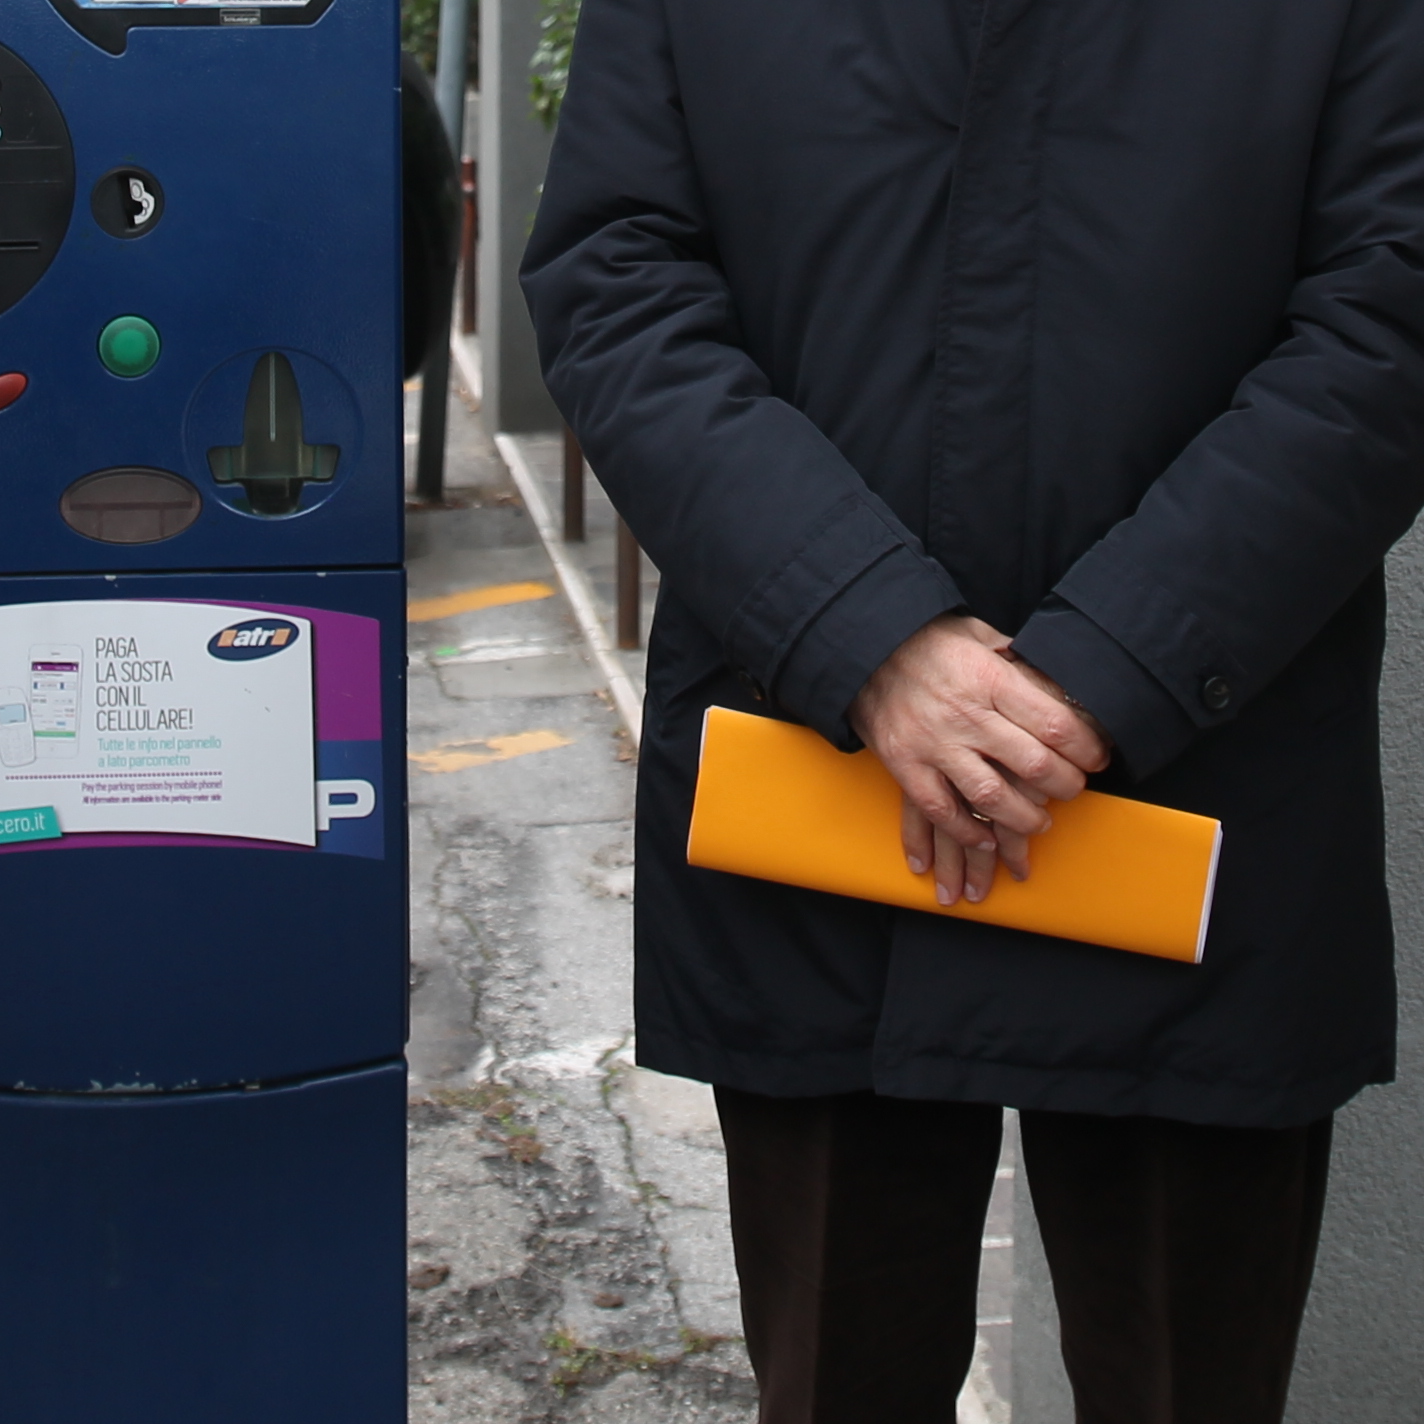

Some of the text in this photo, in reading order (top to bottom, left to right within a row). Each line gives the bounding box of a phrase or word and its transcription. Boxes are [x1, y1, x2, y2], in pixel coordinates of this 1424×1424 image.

[95, 637, 138, 658] PAGA
[95, 661, 174, 683] LA SOSTA
[96, 686, 147, 707] CON IL
[96, 708, 194, 731] CELLULARE!
[98, 736, 222, 753] Tutte le info nel pannello
[98, 754, 191, 769] a lato parcometro
[82, 783, 95, 793] Pay
[96, 782, 107, 791] the
[108, 782, 135, 793] parking
[136, 781, 163, 790] session
[164, 780, 173, 791] by
[174, 780, 197, 789] mobile
[316, 779, 376, 831] P
